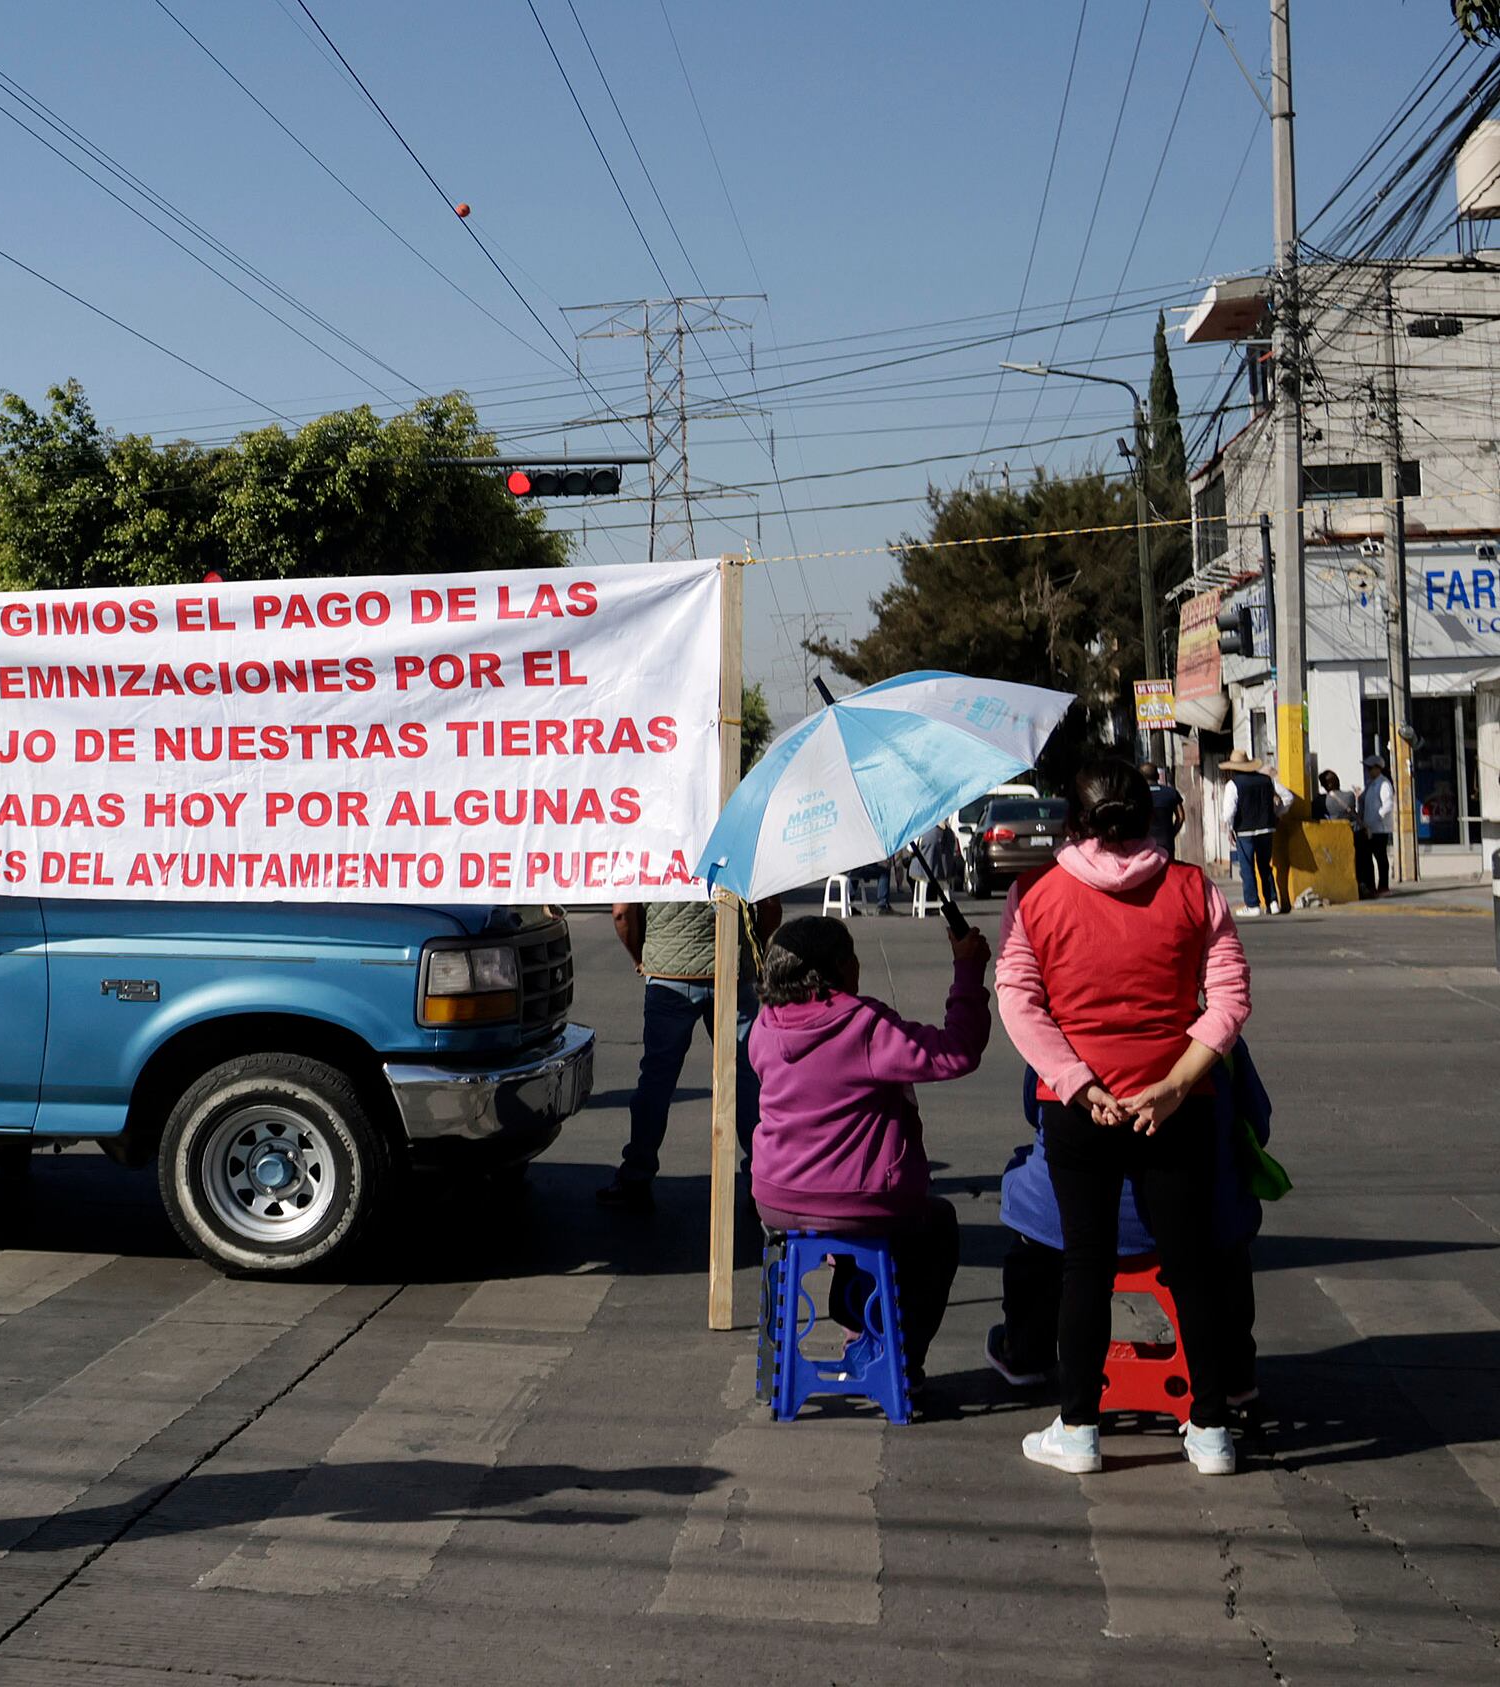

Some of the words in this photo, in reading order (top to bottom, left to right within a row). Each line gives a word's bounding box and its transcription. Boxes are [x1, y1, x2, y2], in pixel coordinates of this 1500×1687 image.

[176, 597, 237, 632] EL
[253, 591, 391, 631] PAGO
[411, 587, 477, 625] DE
[498, 581, 598, 620] LAS
[1426, 569, 1500, 611] FAR
[395, 652, 505, 691] POR
[523, 649, 589, 687] EL
[1139, 703, 1172, 717] CASA
[75, 728, 136, 763] DE
[155, 722, 429, 763] NUESTRAS
[446, 715, 678, 758] TIERRAS
[145, 792, 248, 828] HOY
[265, 791, 370, 828] POR
[386, 786, 642, 827] ALGUNAS
[787, 799, 836, 828] MARIO
[796, 789, 826, 805] VOTA
[41, 851, 115, 886] DEL
[127, 853, 445, 889] AYUNTAMIENTO
[459, 852, 512, 889] DE
